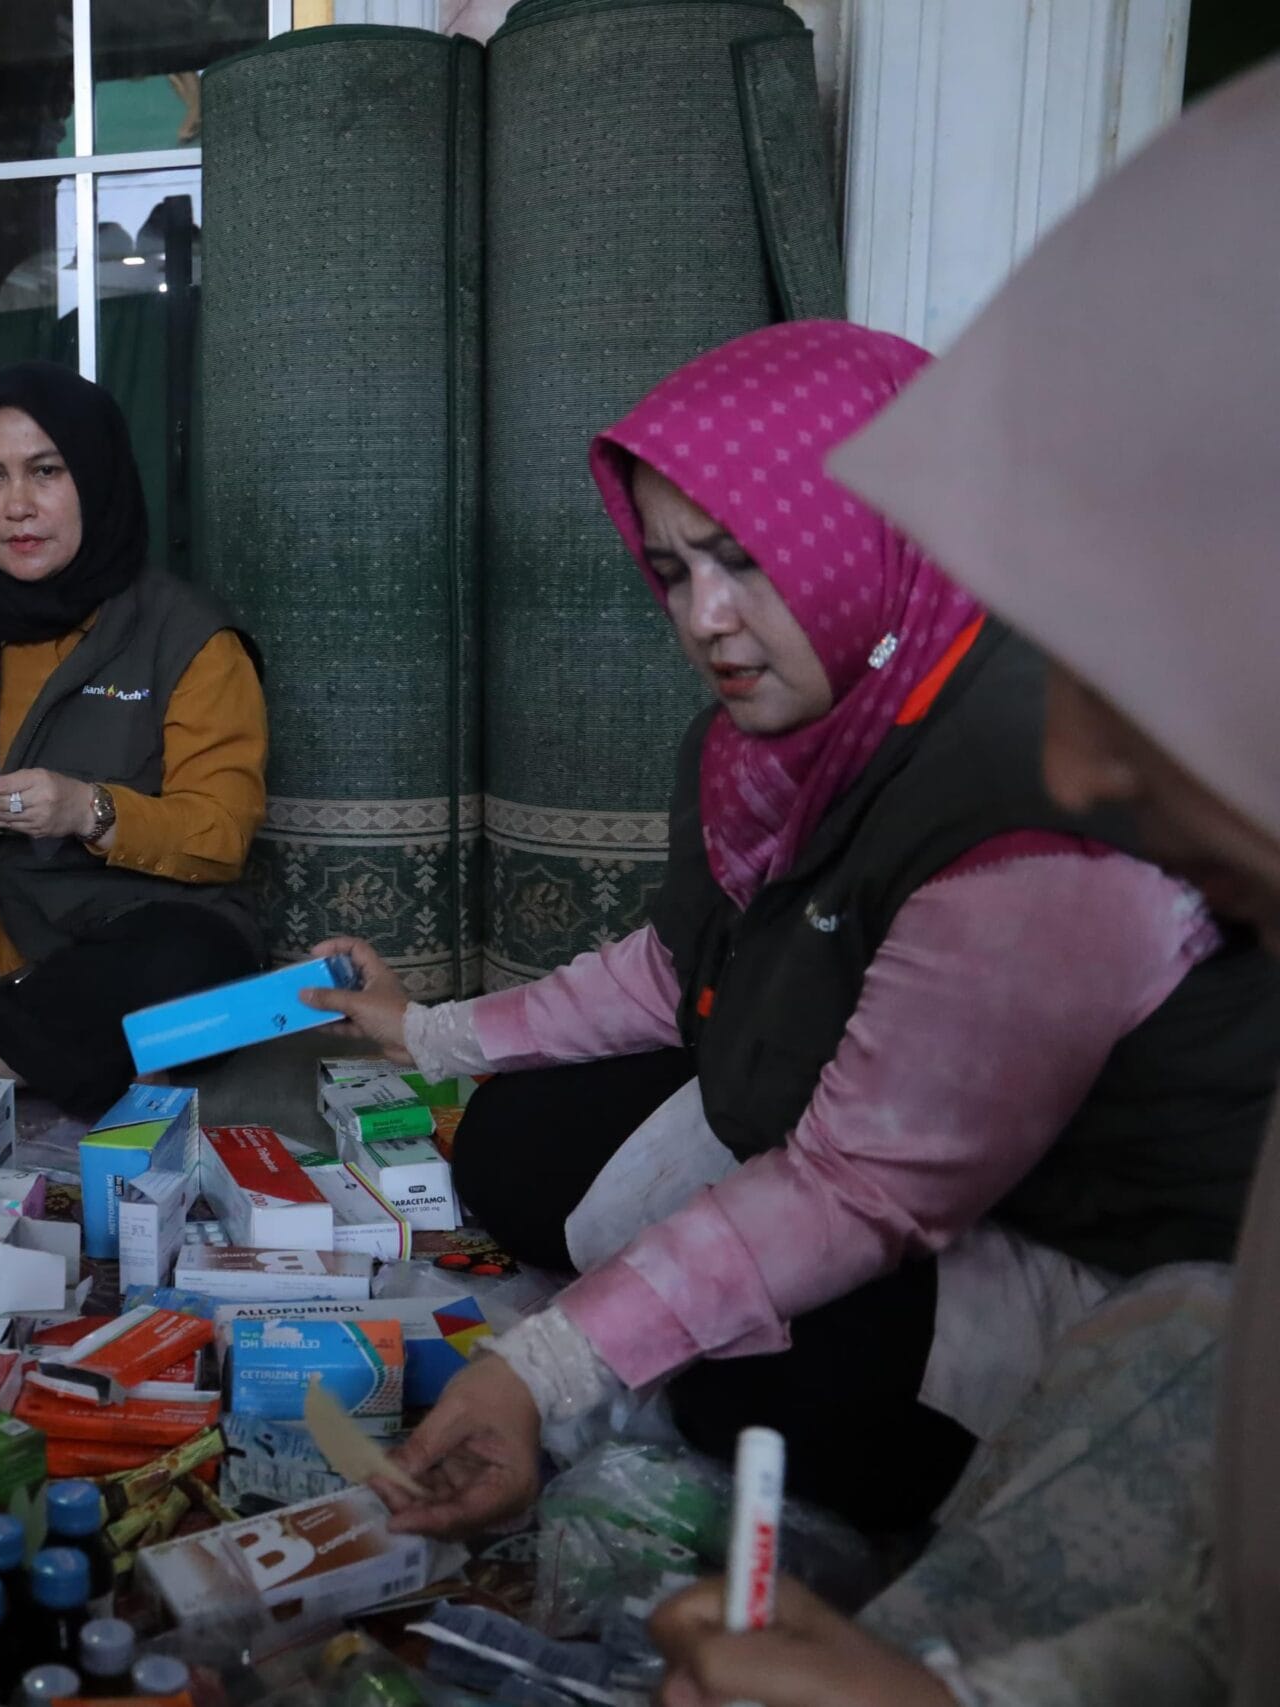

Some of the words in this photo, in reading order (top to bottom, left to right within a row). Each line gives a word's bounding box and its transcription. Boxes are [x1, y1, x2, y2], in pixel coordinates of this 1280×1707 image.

[82, 685, 106, 695] Bank
[115, 690, 142, 700] Aceh
[235, 1304, 365, 1317] ALLOPURINOL
[239, 1369, 300, 1380] CETIRIZINE
[208, 1516, 316, 1592] B
